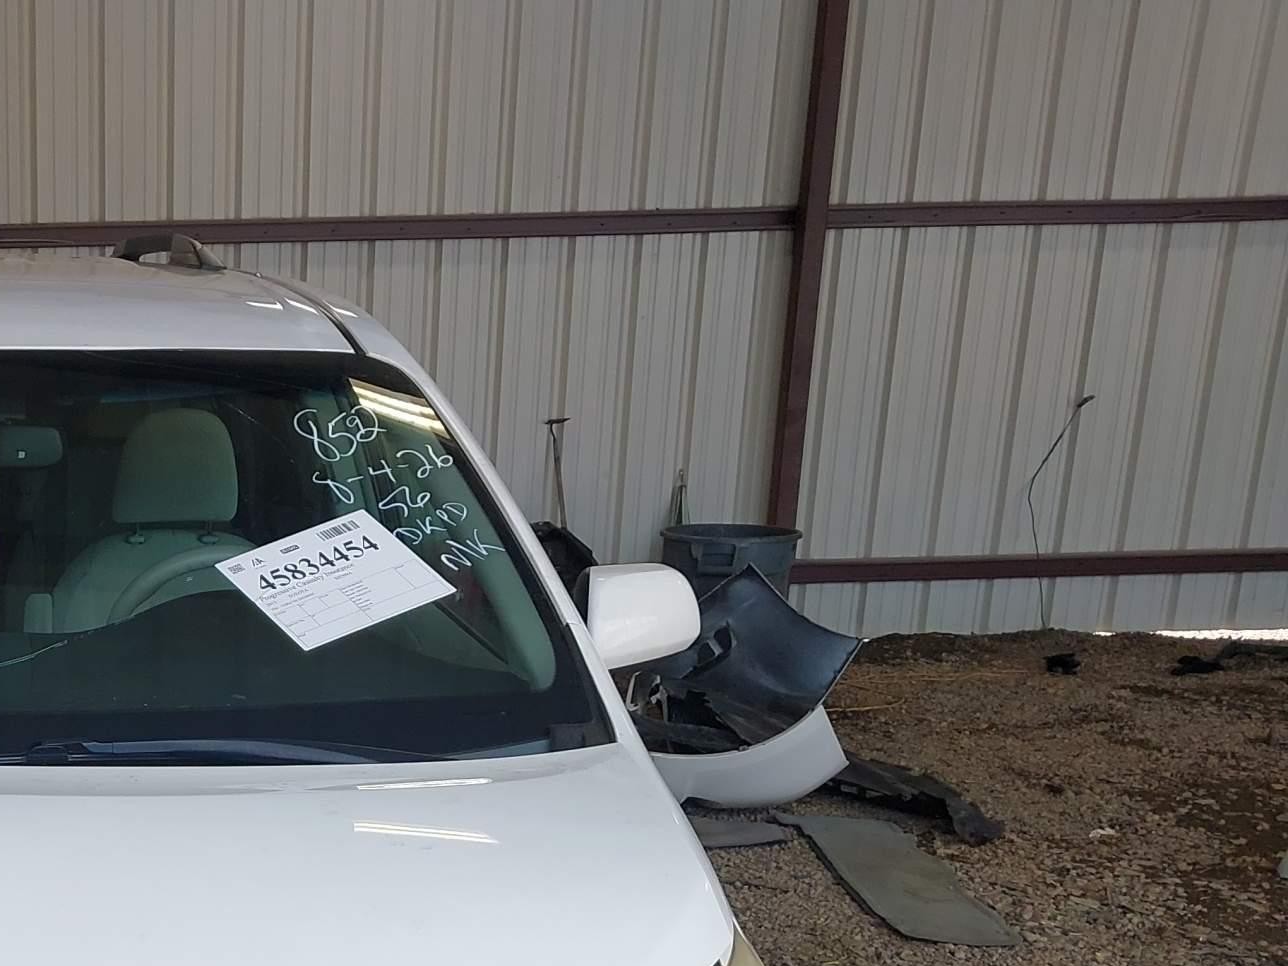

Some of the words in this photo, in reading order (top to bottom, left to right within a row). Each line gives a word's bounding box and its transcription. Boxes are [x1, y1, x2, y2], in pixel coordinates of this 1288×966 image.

[293, 405, 387, 462] 852
[312, 444, 454, 504] 8-4-26
[259, 535, 380, 591] 45834454
